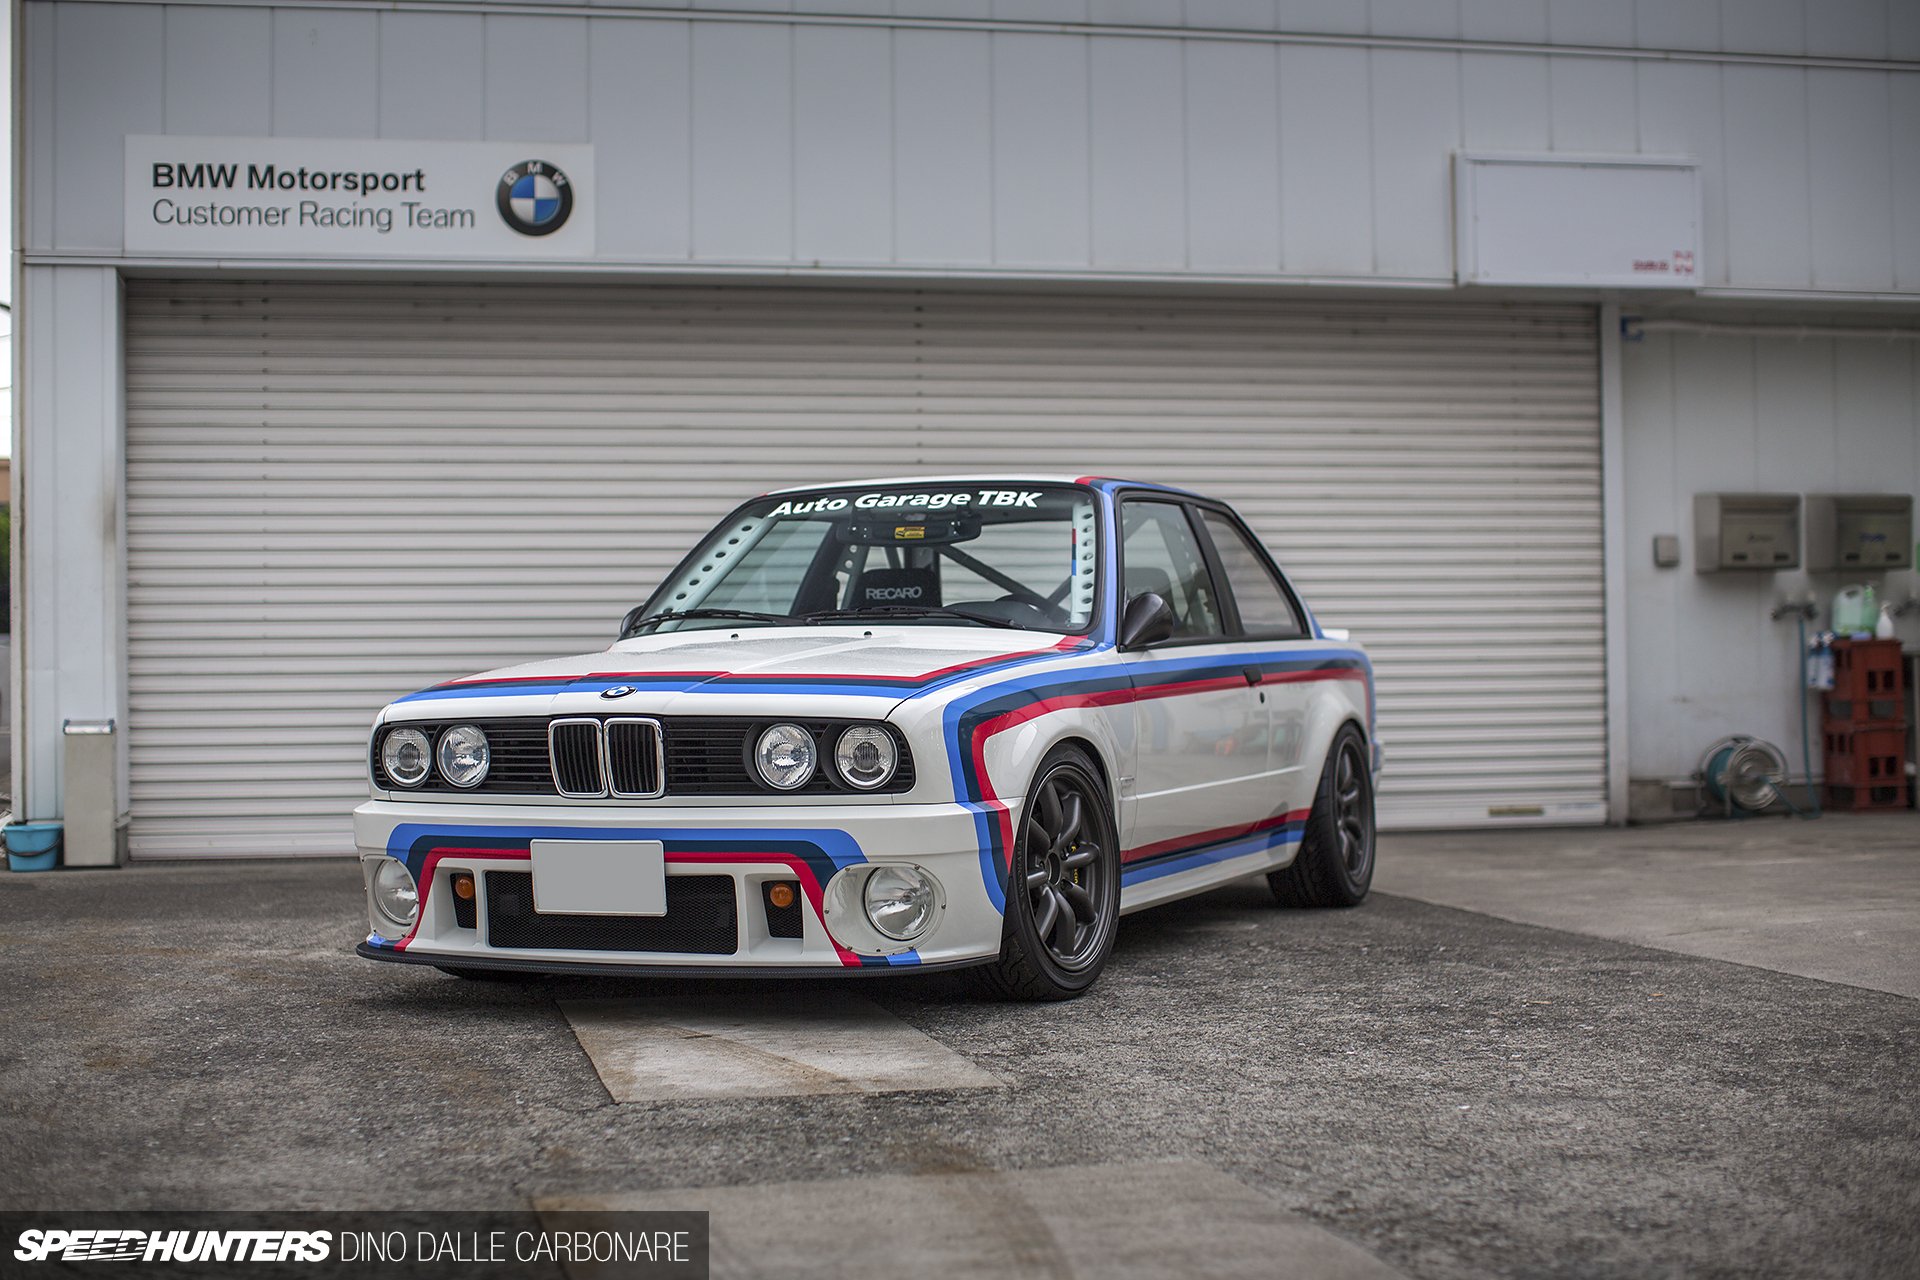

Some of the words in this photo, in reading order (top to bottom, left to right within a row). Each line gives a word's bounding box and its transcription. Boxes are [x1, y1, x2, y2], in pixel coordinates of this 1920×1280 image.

[152, 163, 238, 188] BMW
[247, 164, 426, 196] Motorsport
[503, 161, 566, 187] BMW
[152, 198, 292, 227] Customer
[299, 200, 393, 234] Racing
[401, 201, 475, 229] Team
[767, 497, 849, 518] Auto
[854, 493, 972, 510] Garage
[977, 490, 1043, 508] TBK
[865, 586, 923, 600] RECARO
